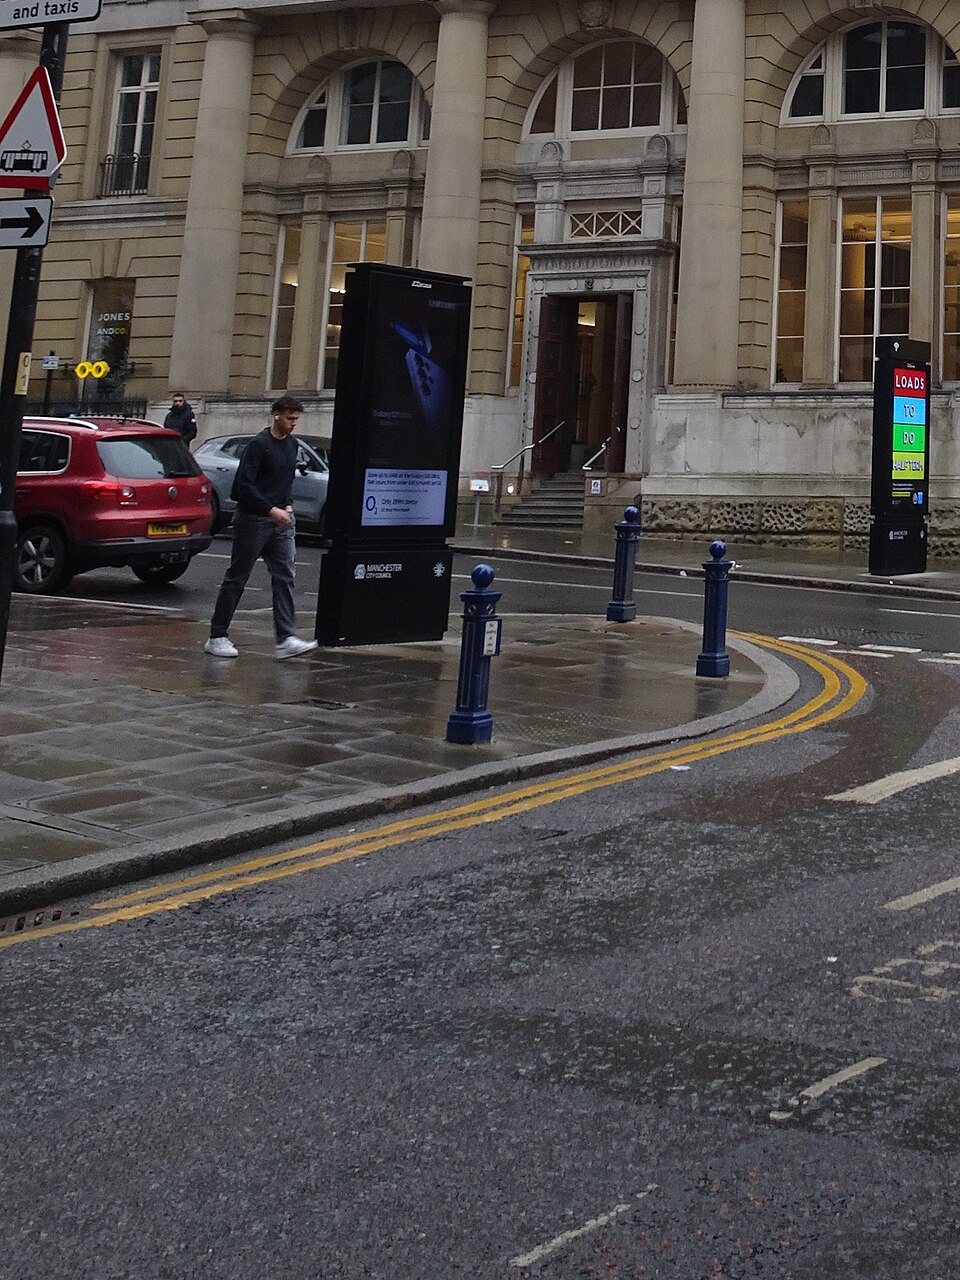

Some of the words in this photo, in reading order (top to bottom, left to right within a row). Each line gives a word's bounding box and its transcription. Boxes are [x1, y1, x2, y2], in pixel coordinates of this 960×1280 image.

[13, 2, 39, 19] and
[45, 0, 79, 16] taxis
[98, 312, 131, 322] JONES
[895, 374, 925, 390] LOADS
[904, 403, 916, 418] TO
[903, 431, 916, 445] DO
[366, 563, 403, 572] MANCHESTER
